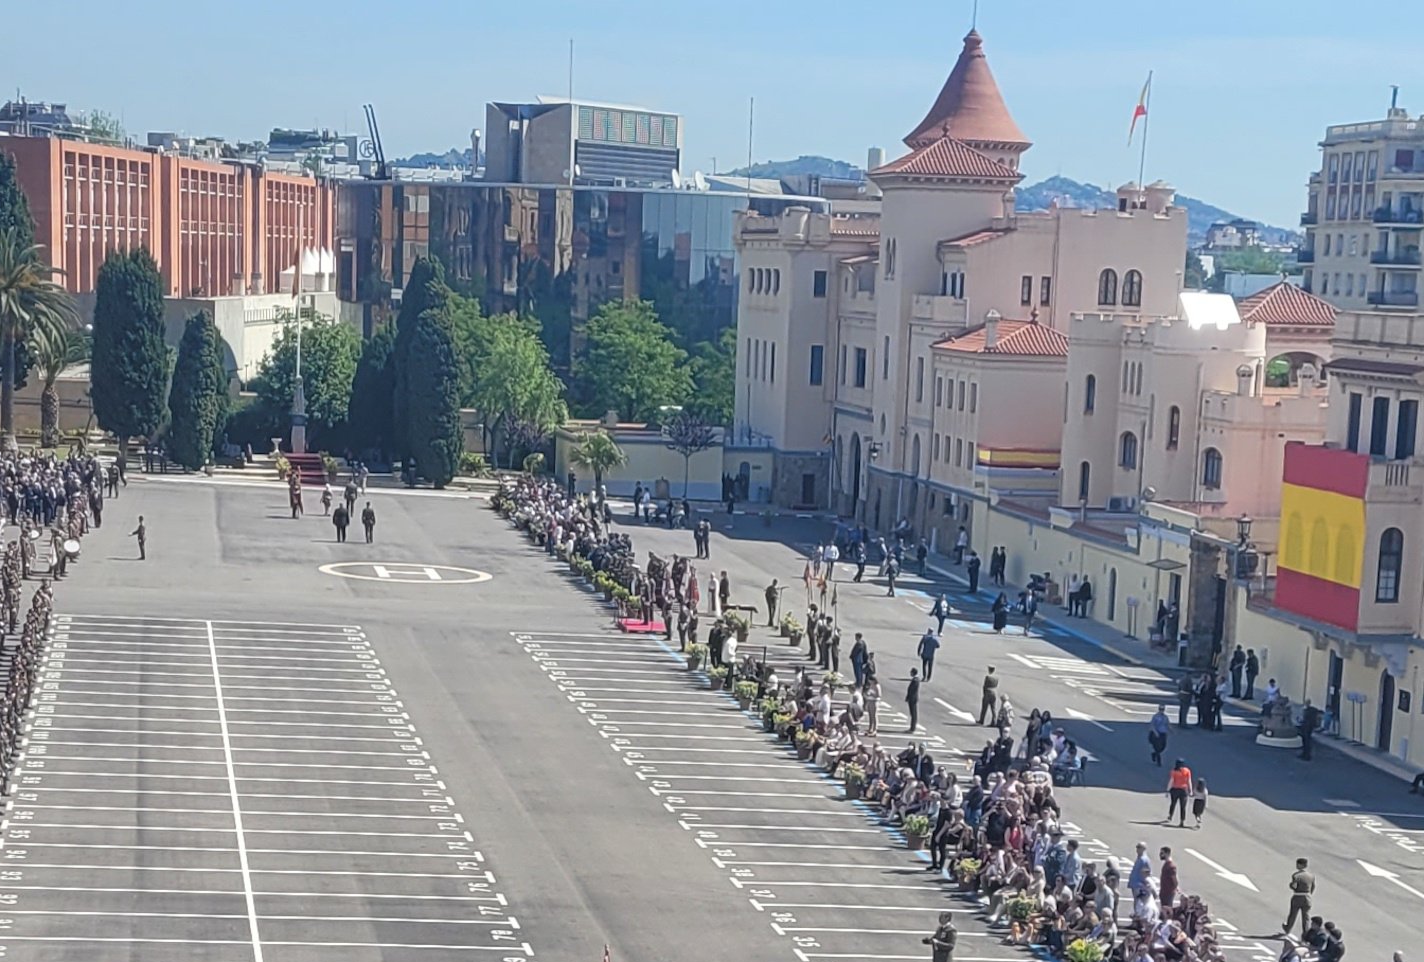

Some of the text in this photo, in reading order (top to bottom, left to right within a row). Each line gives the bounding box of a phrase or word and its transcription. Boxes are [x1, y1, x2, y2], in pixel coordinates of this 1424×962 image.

[373, 566, 442, 580] H
[8, 830, 31, 838] 95
[4, 850, 27, 858] 94
[456, 861, 480, 870] 75
[0, 871, 23, 880] 93
[468, 882, 492, 892] 76
[750, 889, 776, 898] 37
[478, 906, 504, 915] 77
[771, 912, 797, 922] 36
[490, 930, 516, 940] 78
[793, 936, 821, 947] 35
